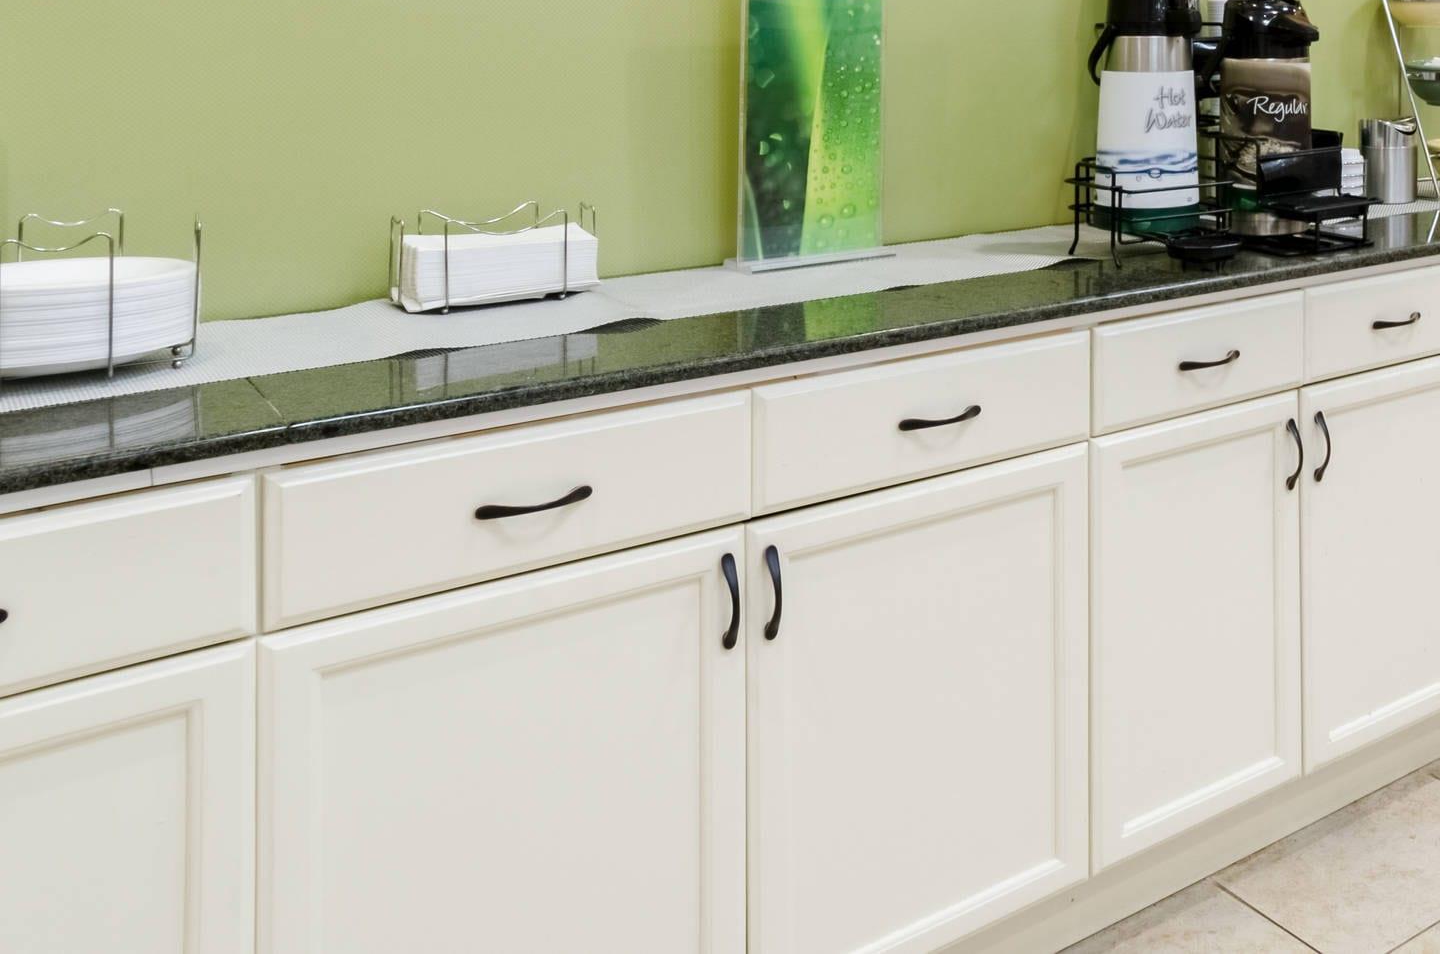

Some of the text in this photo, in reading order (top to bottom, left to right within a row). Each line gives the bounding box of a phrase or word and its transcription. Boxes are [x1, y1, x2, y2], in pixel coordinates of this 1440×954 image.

[1153, 85, 1187, 109] Hot
[1247, 95, 1308, 123] Regular
[1144, 107, 1192, 134] Water
